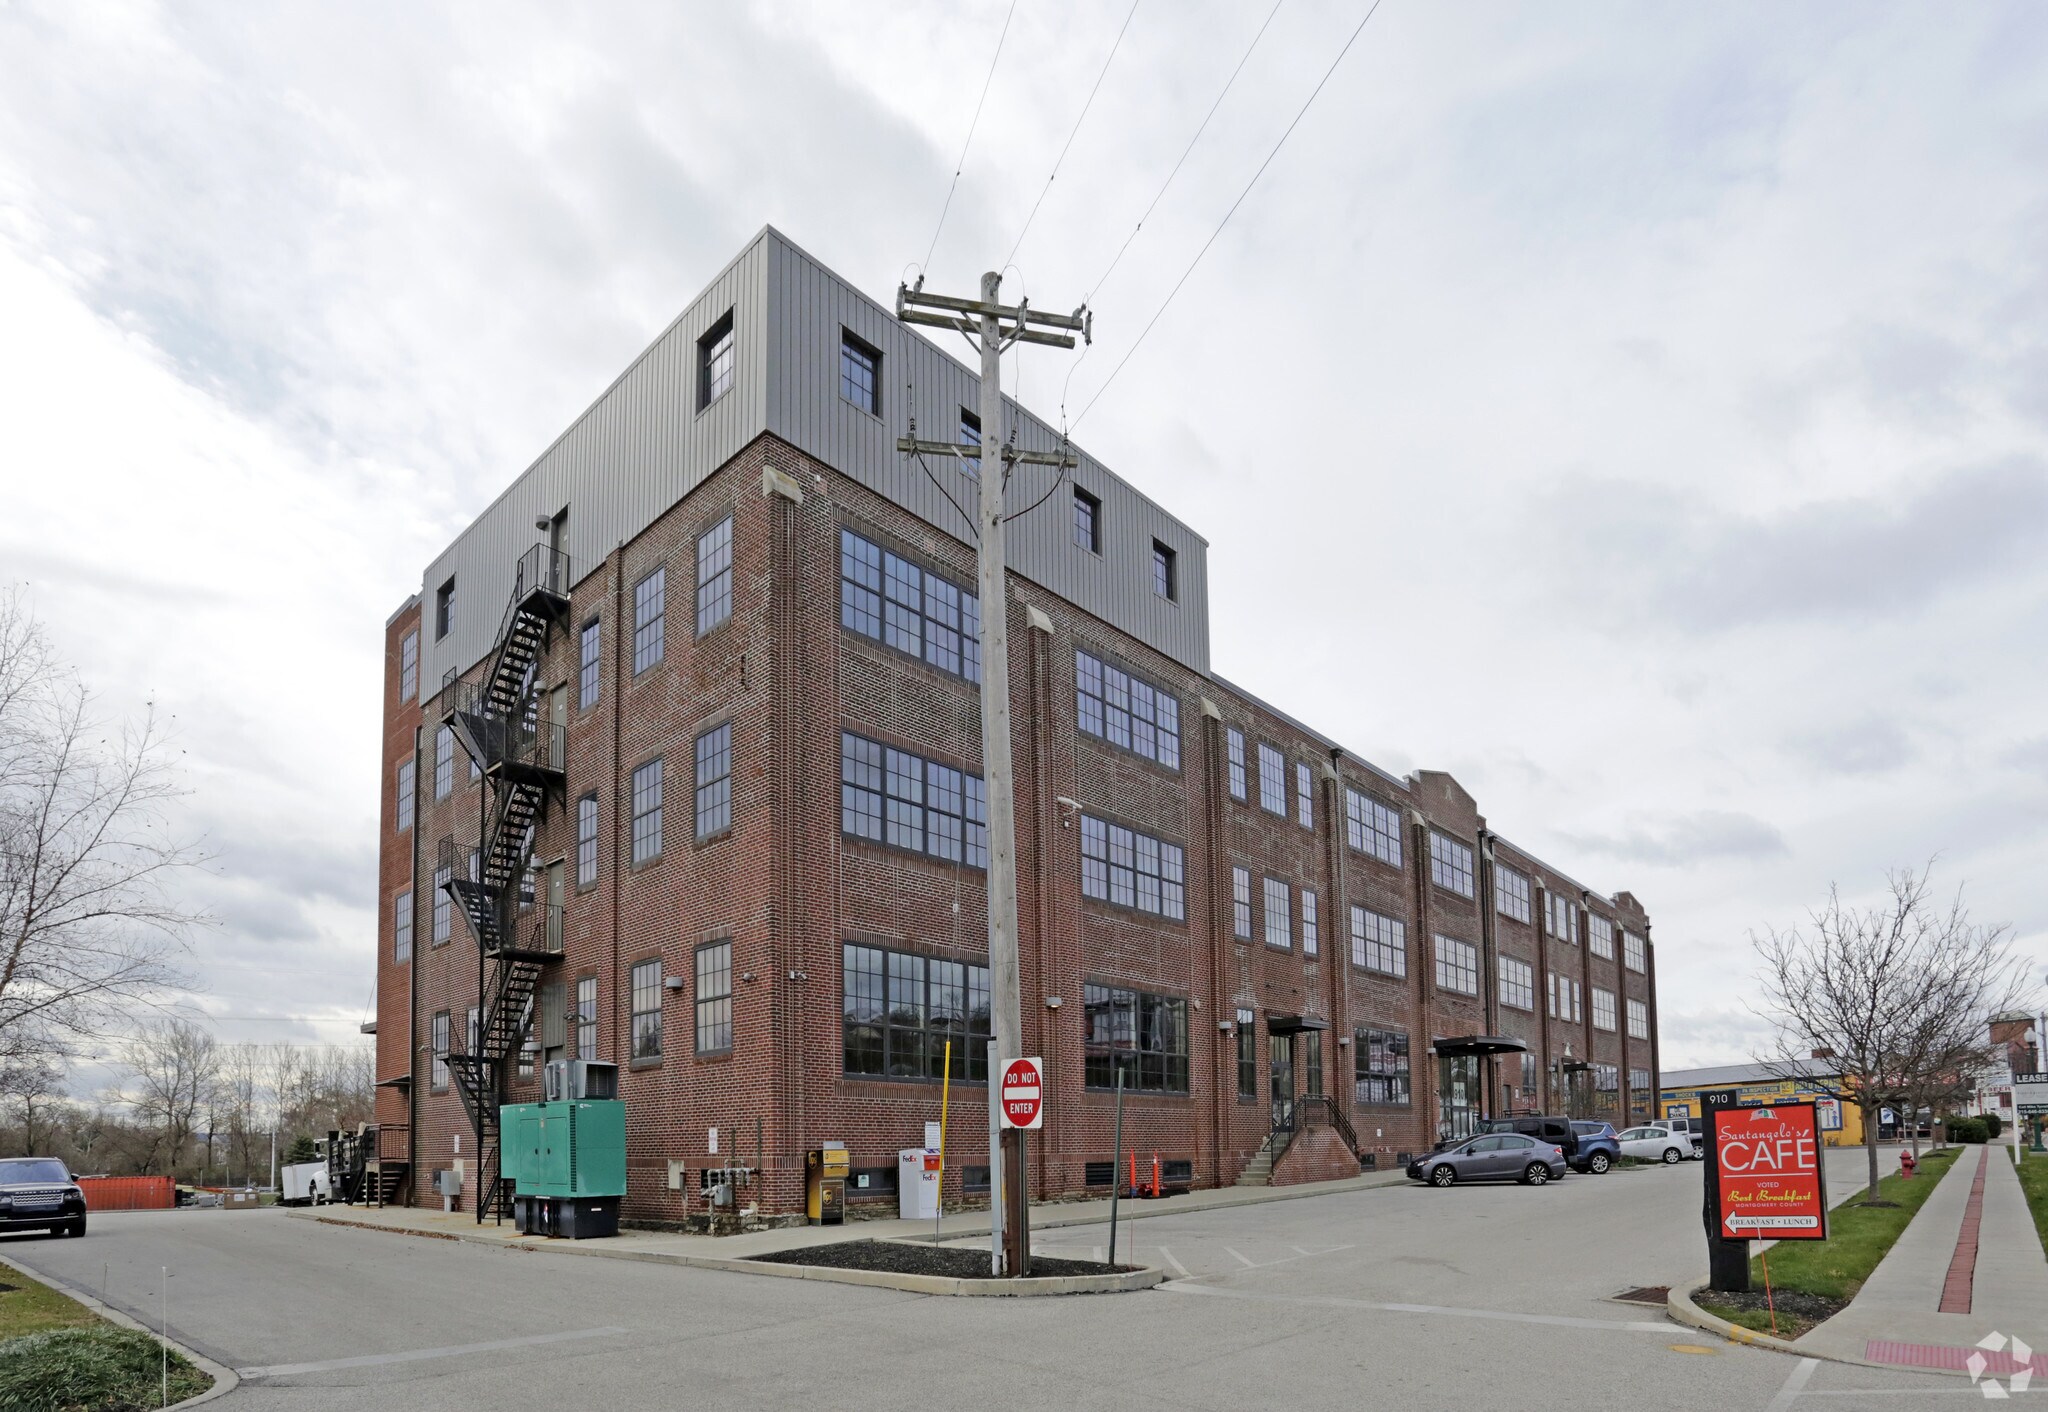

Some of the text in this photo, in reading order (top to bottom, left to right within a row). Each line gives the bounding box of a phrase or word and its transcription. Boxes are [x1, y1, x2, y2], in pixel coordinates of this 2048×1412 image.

[1007, 1072, 1036, 1084] DO NOT
[2016, 1074, 2048, 1083] LEASE
[1709, 1094, 1728, 1104] 910
[1010, 1103, 1033, 1114] ENTER
[1719, 1122, 1802, 1143] Santangelo's
[1721, 1129, 1816, 1172] CAFÉ
[1728, 1190, 1812, 1202] Best Breakfast
